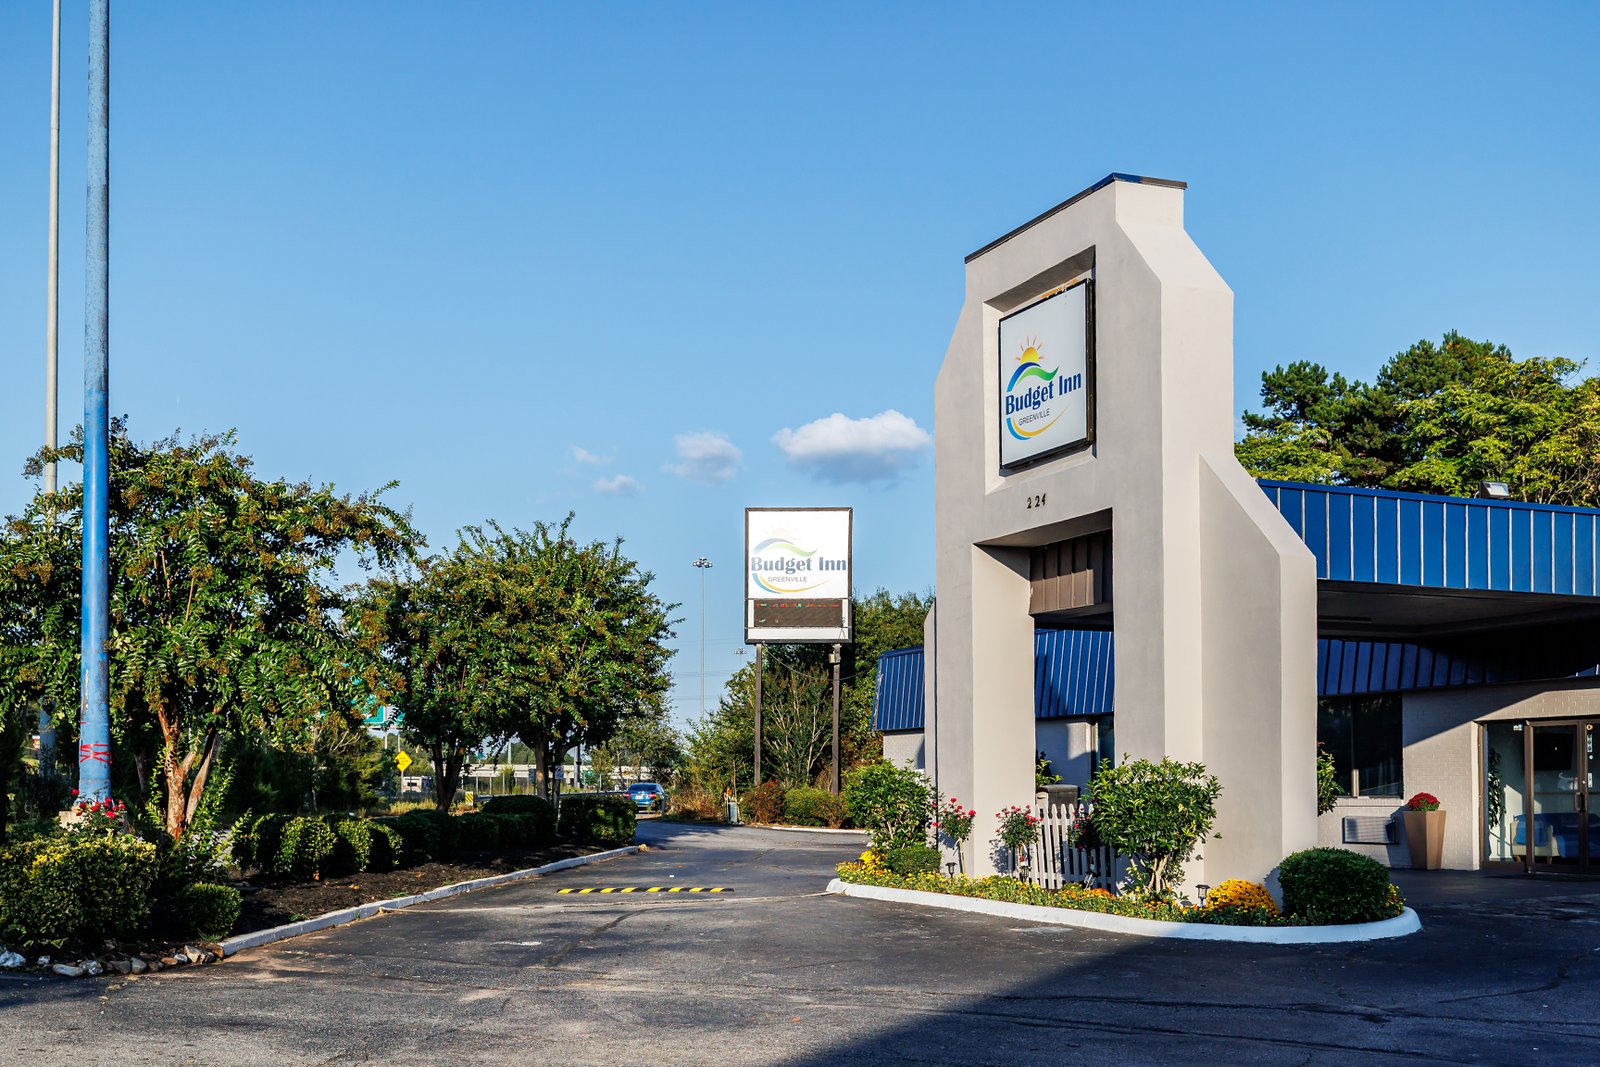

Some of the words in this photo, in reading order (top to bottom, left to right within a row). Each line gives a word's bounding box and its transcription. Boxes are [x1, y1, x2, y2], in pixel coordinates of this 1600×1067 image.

[1005, 382, 1053, 415] Budget
[1059, 373, 1081, 396] Inn
[1018, 409, 1050, 426] GREENVILLE
[1027, 493, 1046, 509] 224
[751, 557, 812, 574] Budget
[818, 556, 847, 571] Inn
